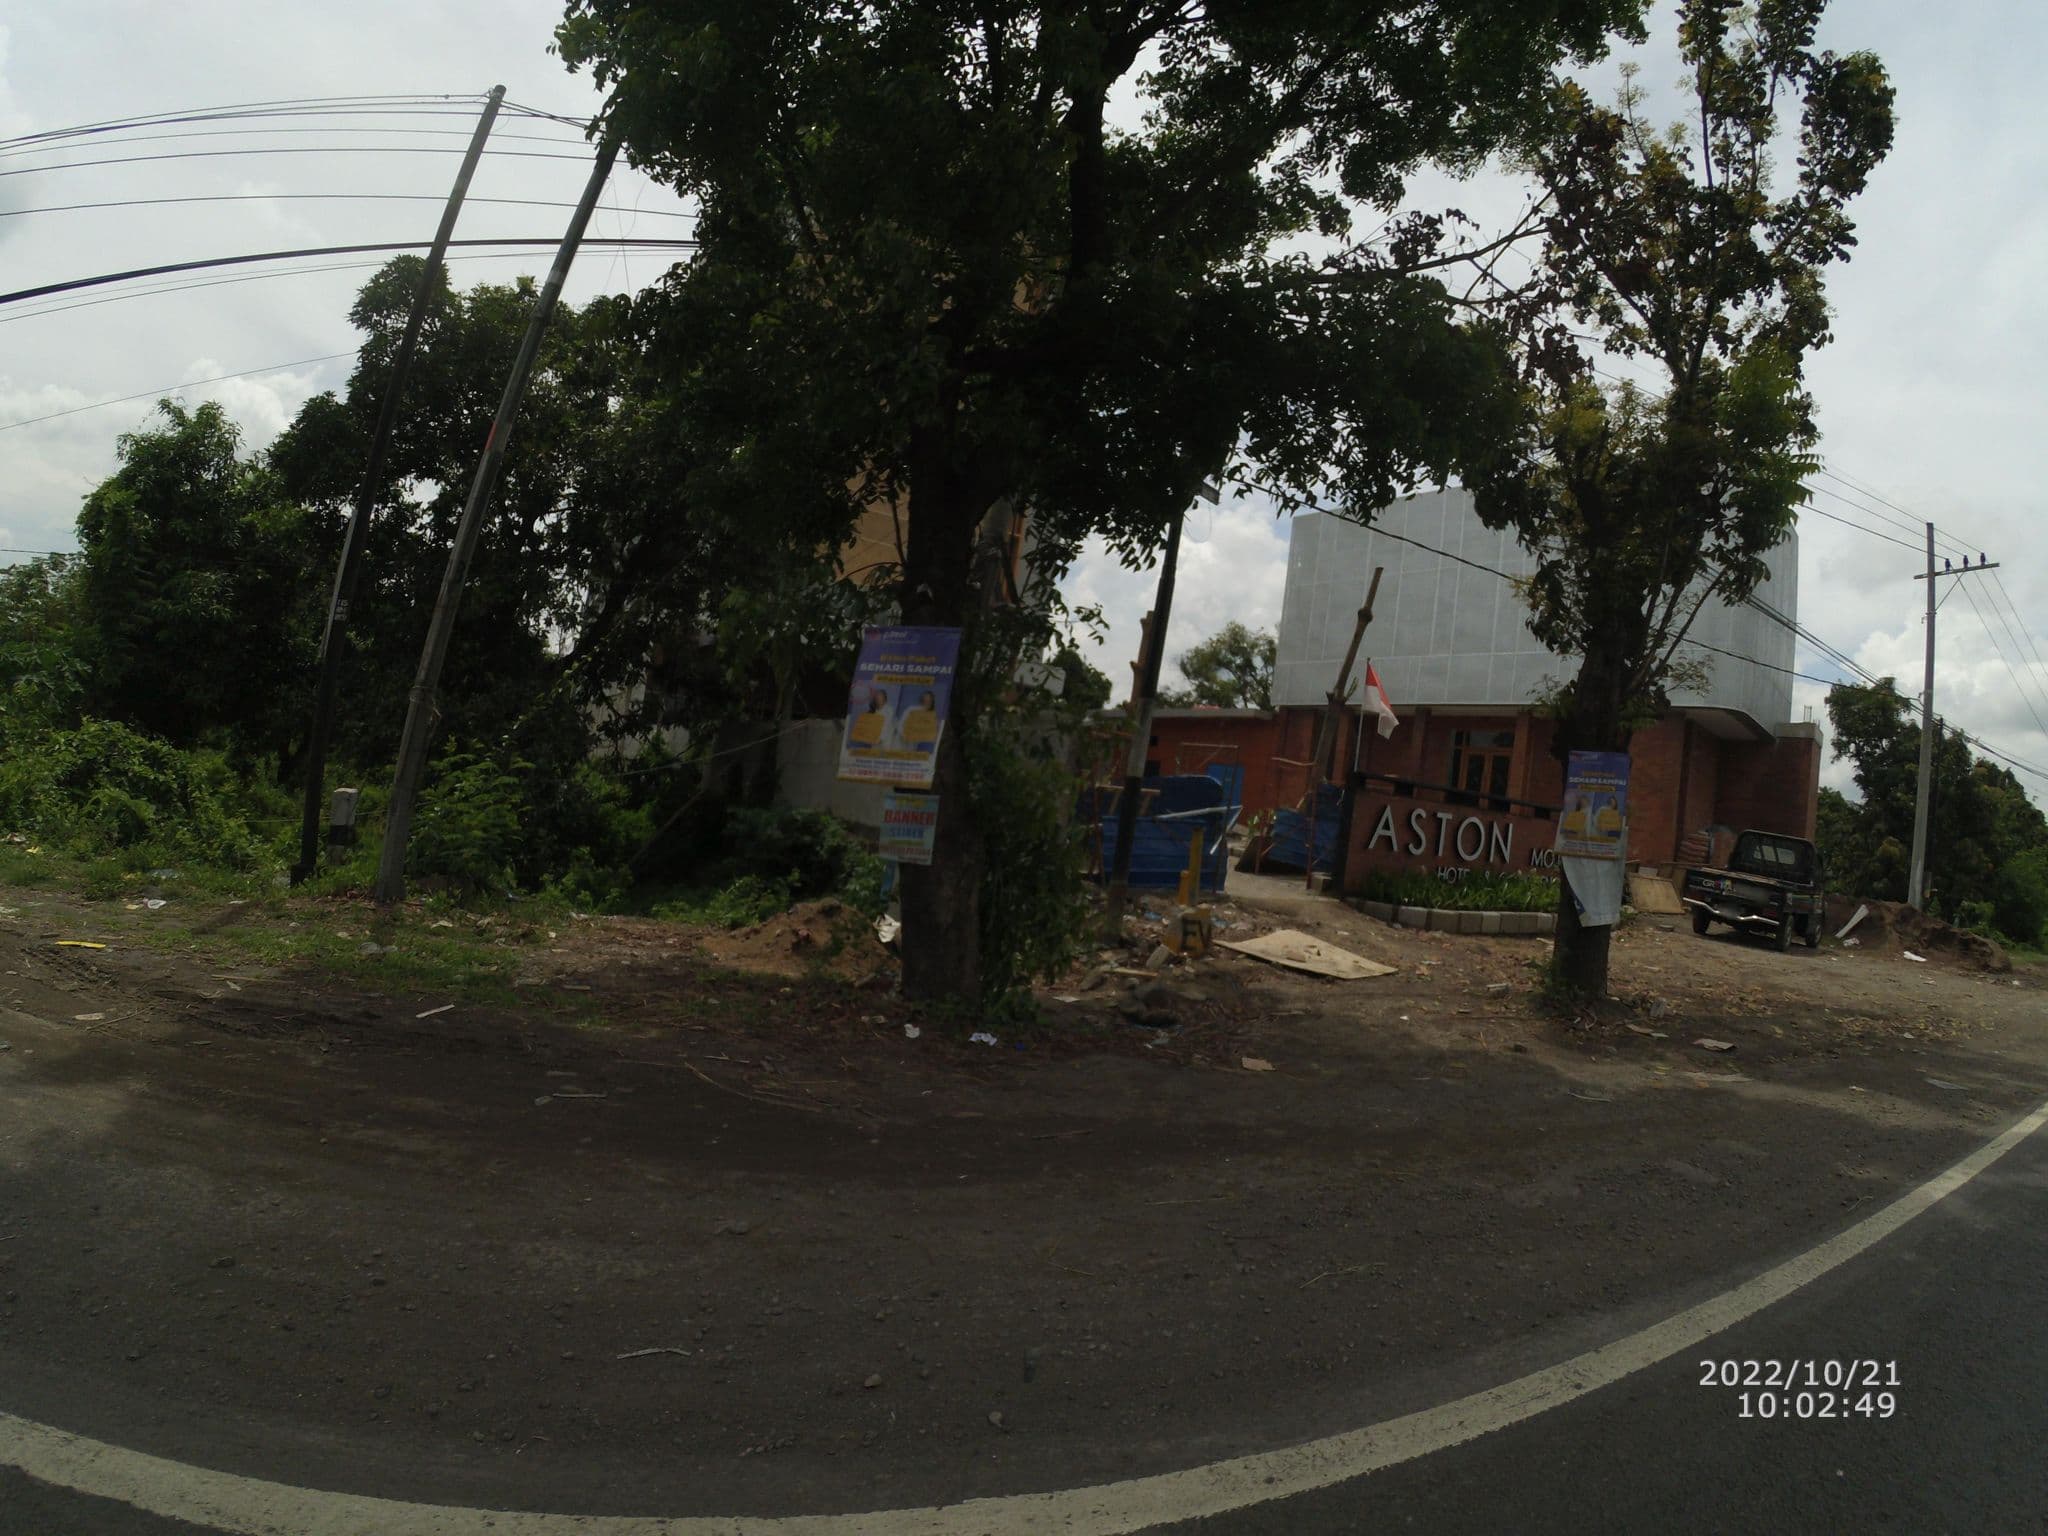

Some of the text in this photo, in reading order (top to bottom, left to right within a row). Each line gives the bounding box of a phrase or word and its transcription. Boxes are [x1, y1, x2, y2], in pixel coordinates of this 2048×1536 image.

[860, 663, 952, 675] SEHARI SAMPAI
[1368, 804, 1514, 865] ASTON
[1437, 866, 1471, 884] HOT
